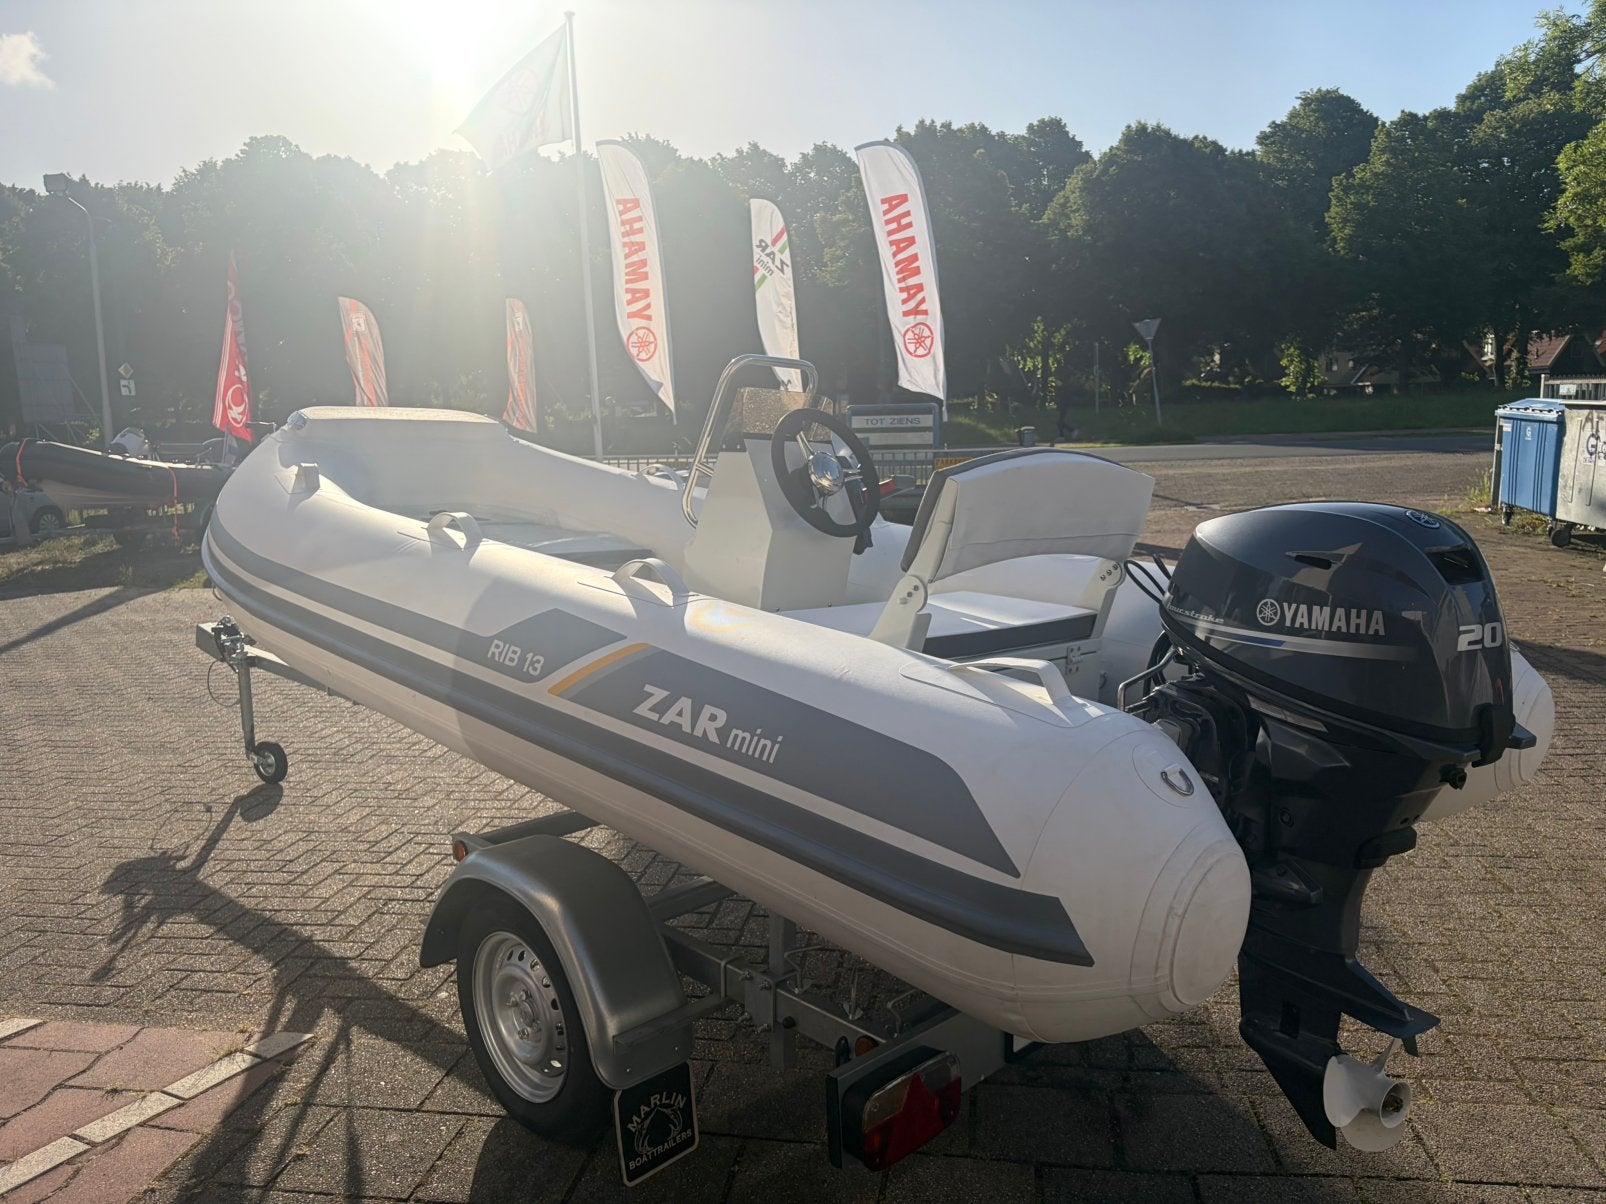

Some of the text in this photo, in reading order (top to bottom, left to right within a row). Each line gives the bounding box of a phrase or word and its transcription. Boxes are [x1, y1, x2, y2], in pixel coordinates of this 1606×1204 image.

[864, 417, 921, 426] TOT ZIENS
[1282, 602, 1386, 636] YAMAHA
[1457, 621, 1502, 652] 20
[487, 639, 545, 677] RIB 13
[632, 684, 784, 764] ZAR mini
[627, 1091, 687, 1133] MARLIN
[629, 1129, 692, 1170] BOATTRAILERS
